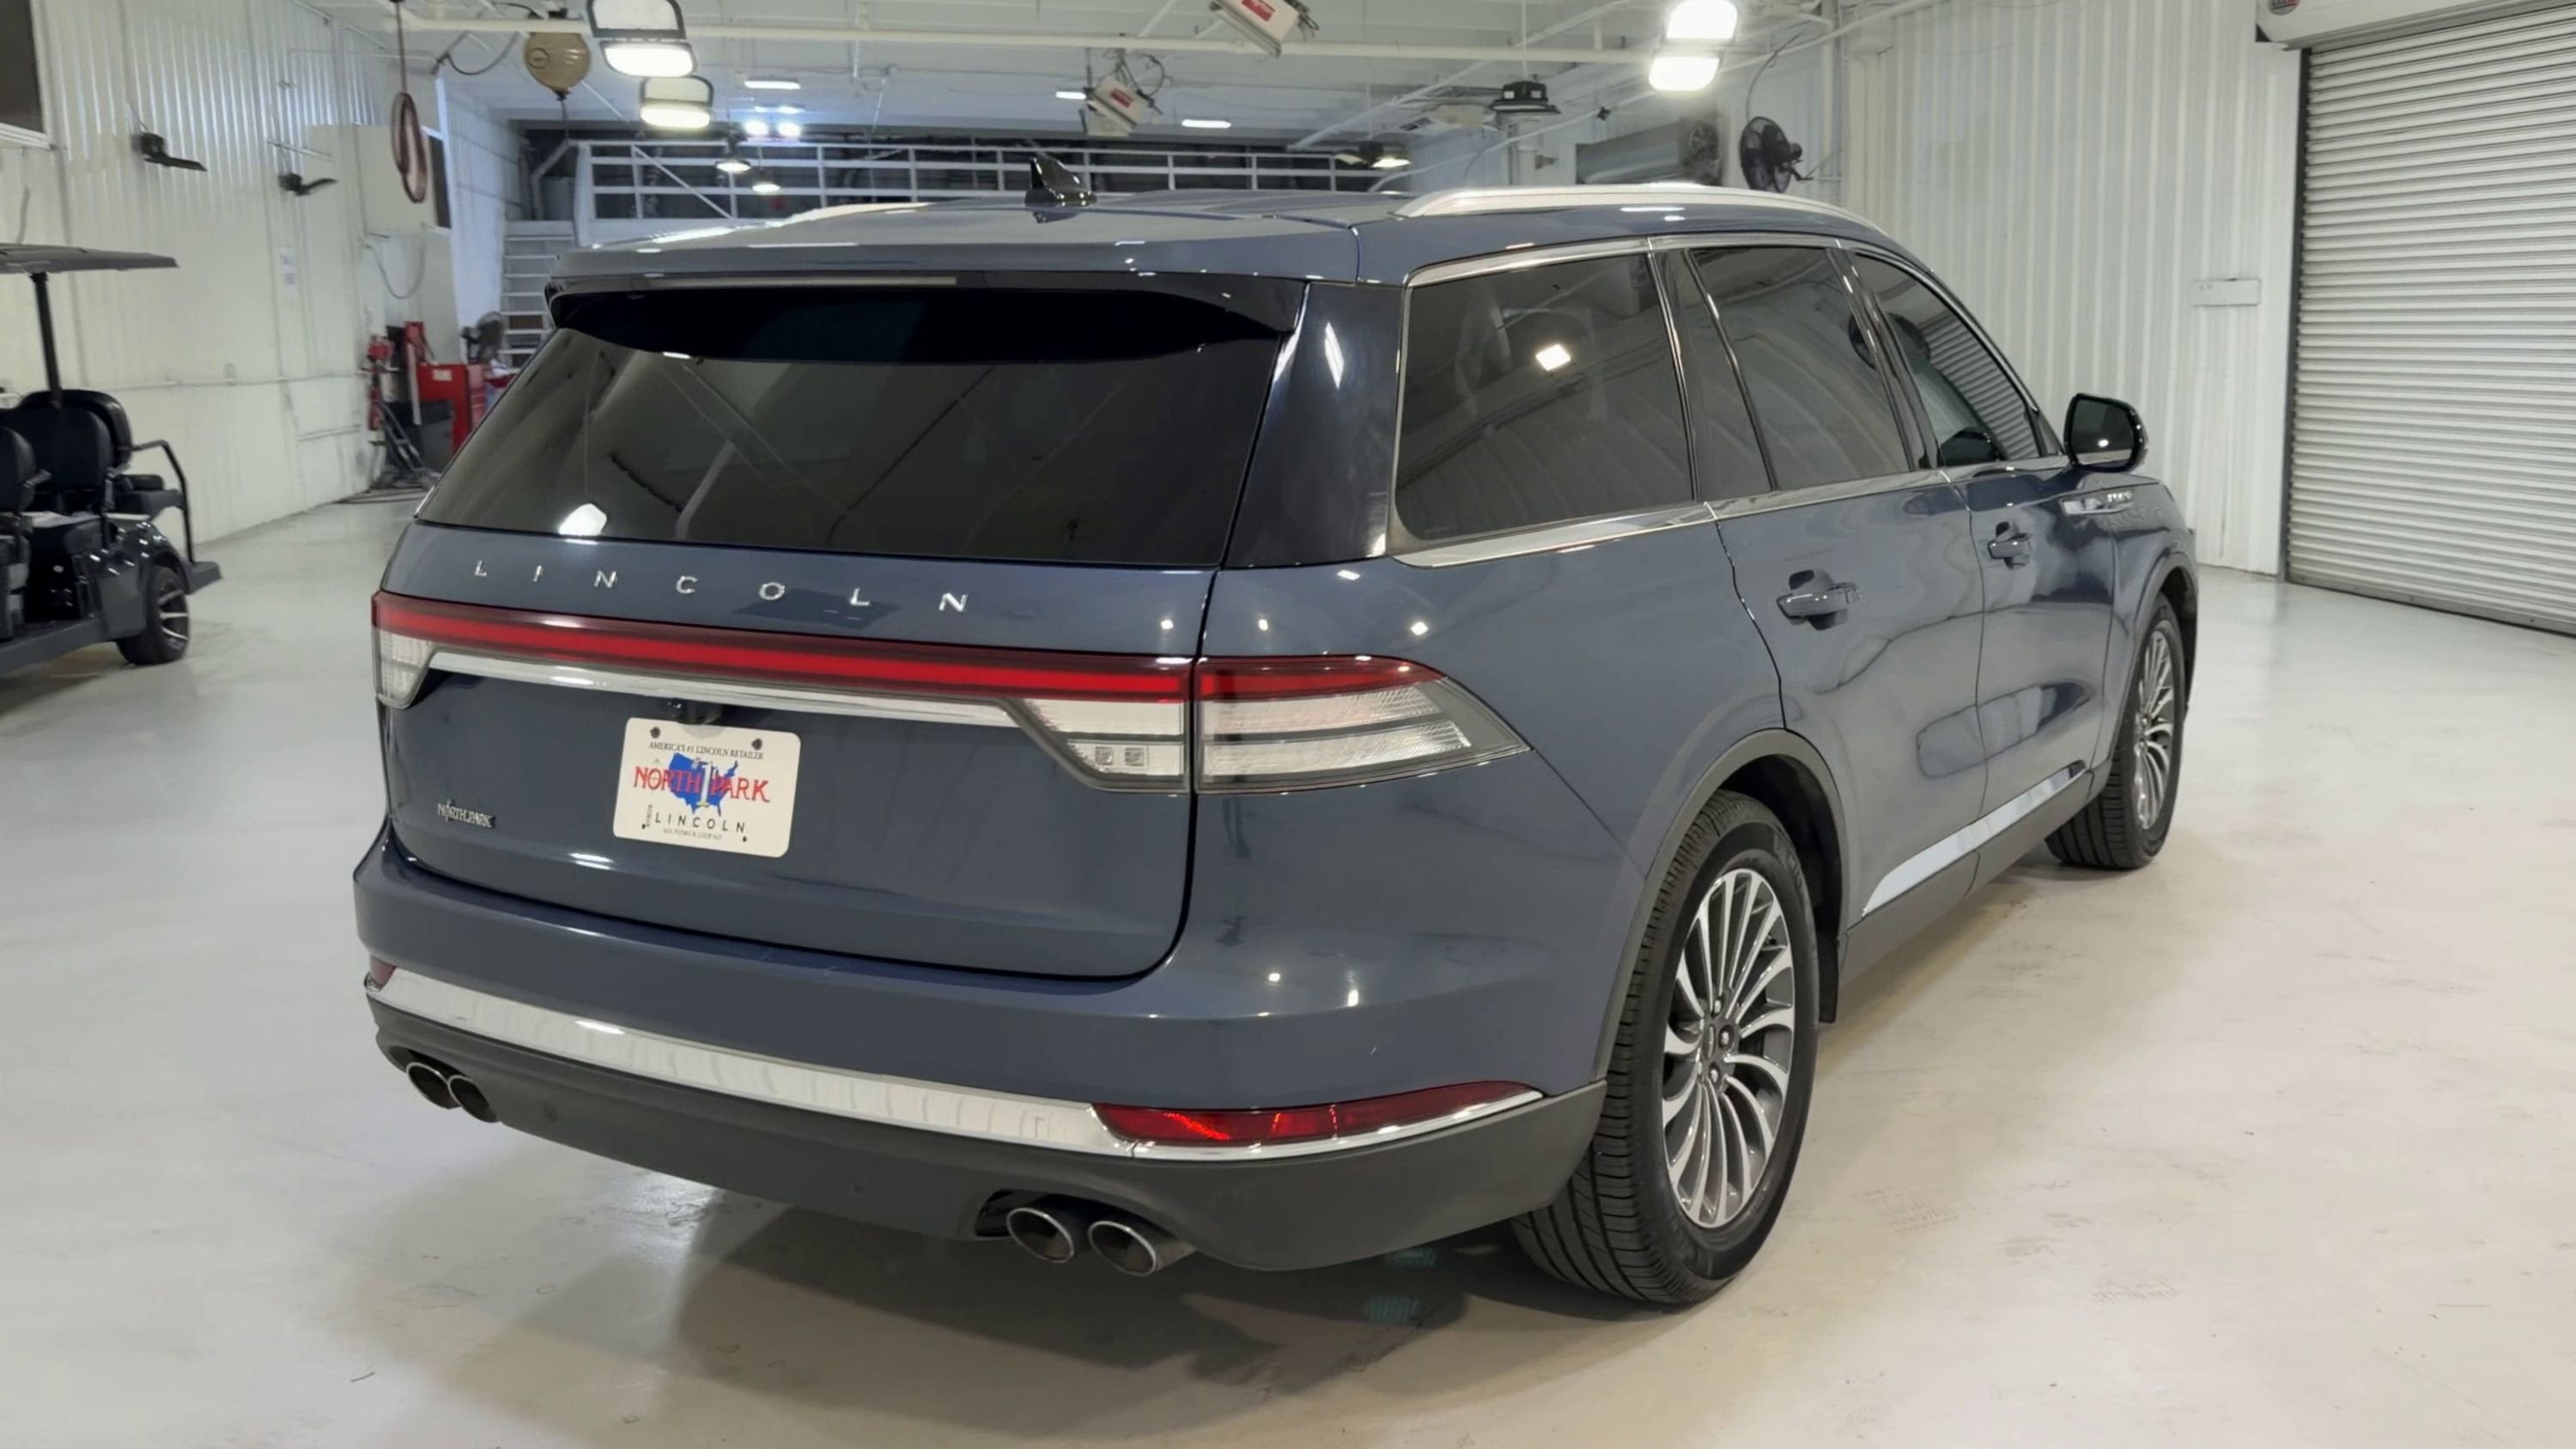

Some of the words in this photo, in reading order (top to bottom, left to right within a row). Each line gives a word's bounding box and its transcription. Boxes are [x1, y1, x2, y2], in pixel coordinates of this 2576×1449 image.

[474, 560, 969, 612] LINCOLN
[649, 741, 686, 752] AMERICA'S
[696, 745, 729, 757] LINCOLN
[730, 749, 763, 760] RETAILER
[633, 766, 701, 794] NORTH
[711, 773, 770, 803] PARK
[654, 812, 745, 834] LINCOLN
